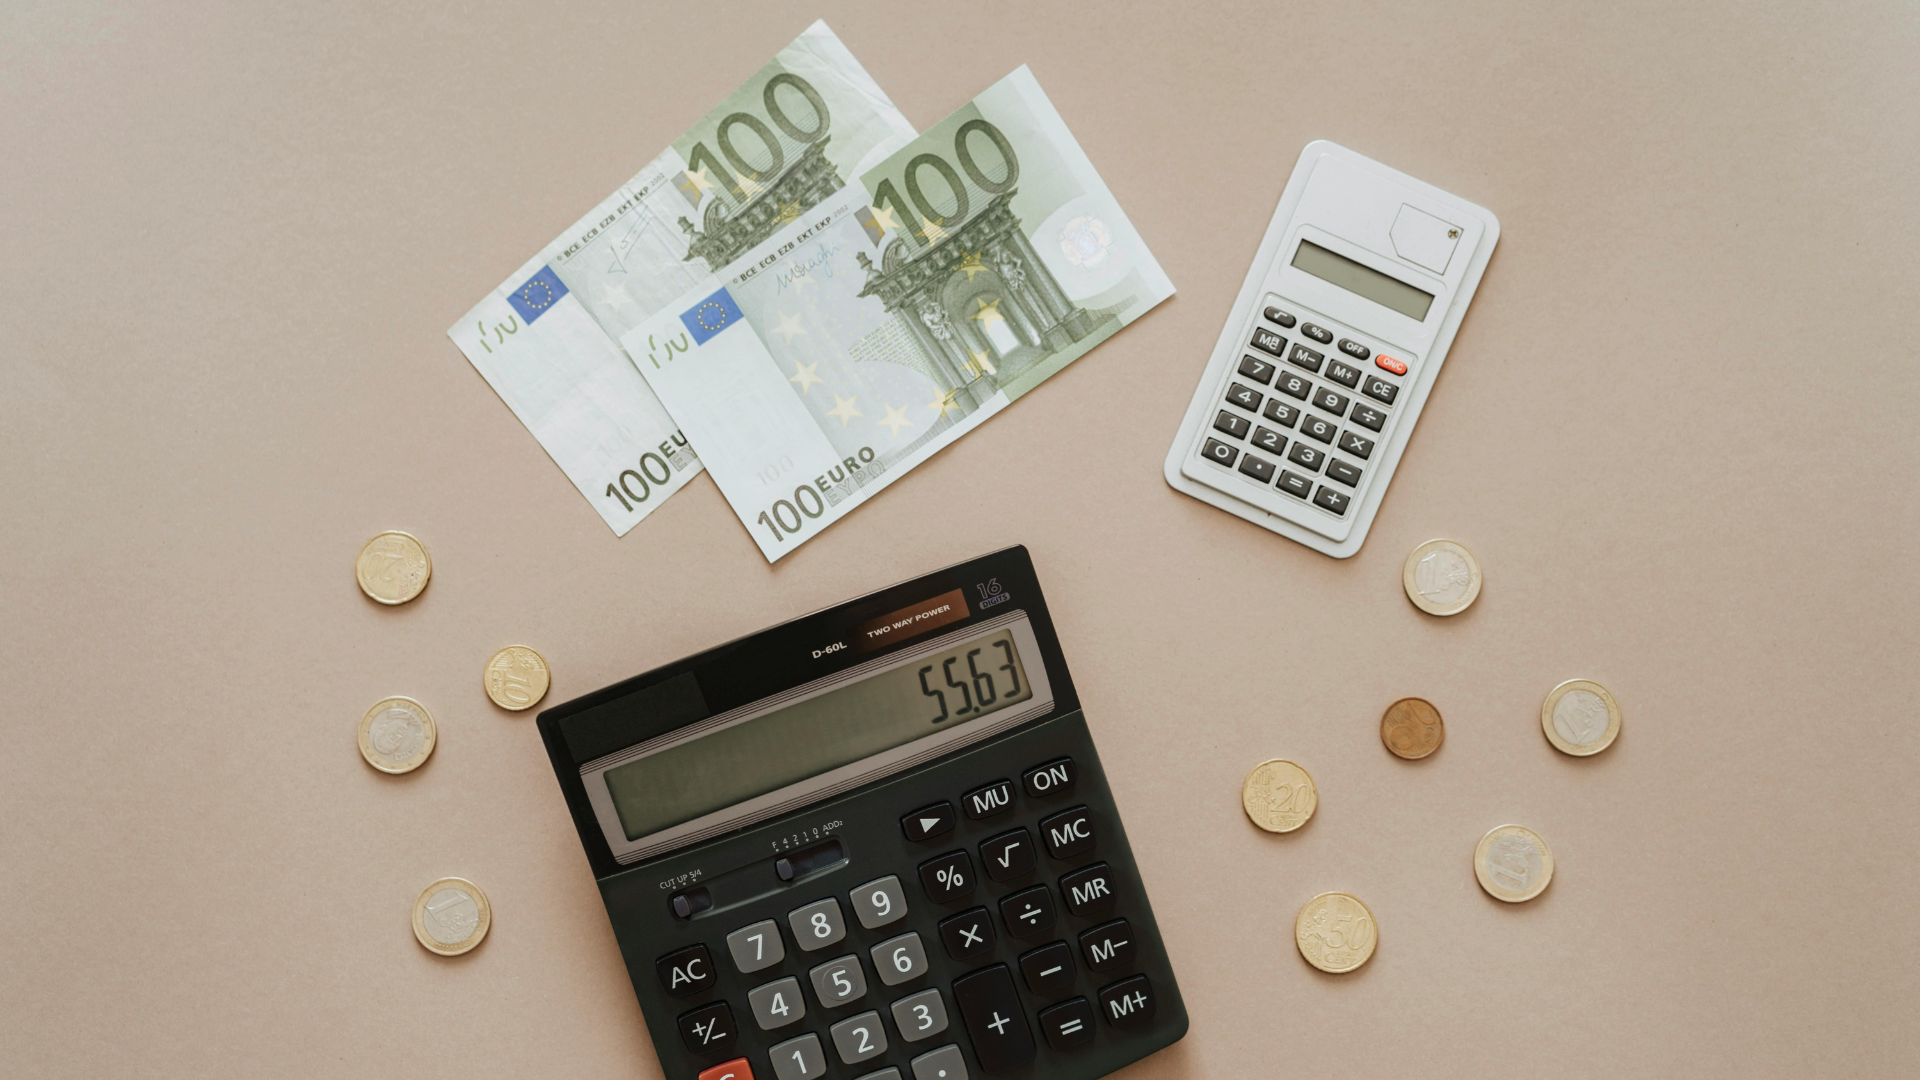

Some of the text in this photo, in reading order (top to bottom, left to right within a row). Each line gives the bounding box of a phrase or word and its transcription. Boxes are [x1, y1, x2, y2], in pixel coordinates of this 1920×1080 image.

[688, 72, 831, 205] 100
[872, 119, 1019, 248] 100
[564, 242, 580, 258] BCE
[582, 228, 598, 243] ECB
[600, 214, 616, 229] EZB
[617, 200, 634, 215] EKT
[634, 186, 650, 202] EKP
[650, 172, 665, 186] 2002
[740, 266, 758, 282] BCE
[759, 254, 776, 269] ECB
[778, 242, 795, 256] EZB
[796, 228, 814, 243] EKT
[814, 216, 832, 230] EKP
[833, 205, 848, 218] 2002
[1346, 342, 1364, 354] OFF
[1254, 362, 1264, 374] 7
[1334, 366, 1353, 380] M+
[1238, 390, 1252, 402] 4
[1287, 378, 1302, 392] 8
[1372, 382, 1392, 397] CE
[1276, 406, 1290, 418] 5
[1325, 394, 1338, 408] 9
[1230, 418, 1238, 429] 1
[1313, 422, 1326, 434] 6
[1263, 433, 1278, 447] 2
[1300, 449, 1316, 462] 3
[606, 452, 671, 513] 100
[814, 446, 875, 493] EURO
[758, 484, 824, 542] 100
[976, 578, 1002, 600] 16
[982, 592, 1009, 609] DIGITS
[866, 604, 950, 638] TWO WAY POWER
[812, 641, 848, 659] D-60L
[918, 639, 1021, 724] 55.63
[1033, 764, 1069, 791] ON
[972, 786, 1010, 814] MU
[1270, 783, 1311, 814] 20
[772, 841, 777, 849] F
[1050, 818, 1091, 848] MC
[659, 869, 702, 890] CUT UP 5/4
[1071, 878, 1111, 906] MR
[871, 890, 891, 916] 9
[810, 912, 832, 938] 8
[1325, 914, 1372, 950] 50
[748, 934, 764, 961] 7
[892, 947, 913, 973] 6
[671, 958, 706, 990] AC
[831, 969, 852, 997] 5
[770, 992, 789, 1017] 4
[912, 1004, 934, 1030] 3
[1110, 990, 1148, 1020] M+
[852, 1026, 875, 1054] 2
[792, 1050, 808, 1075] 1
